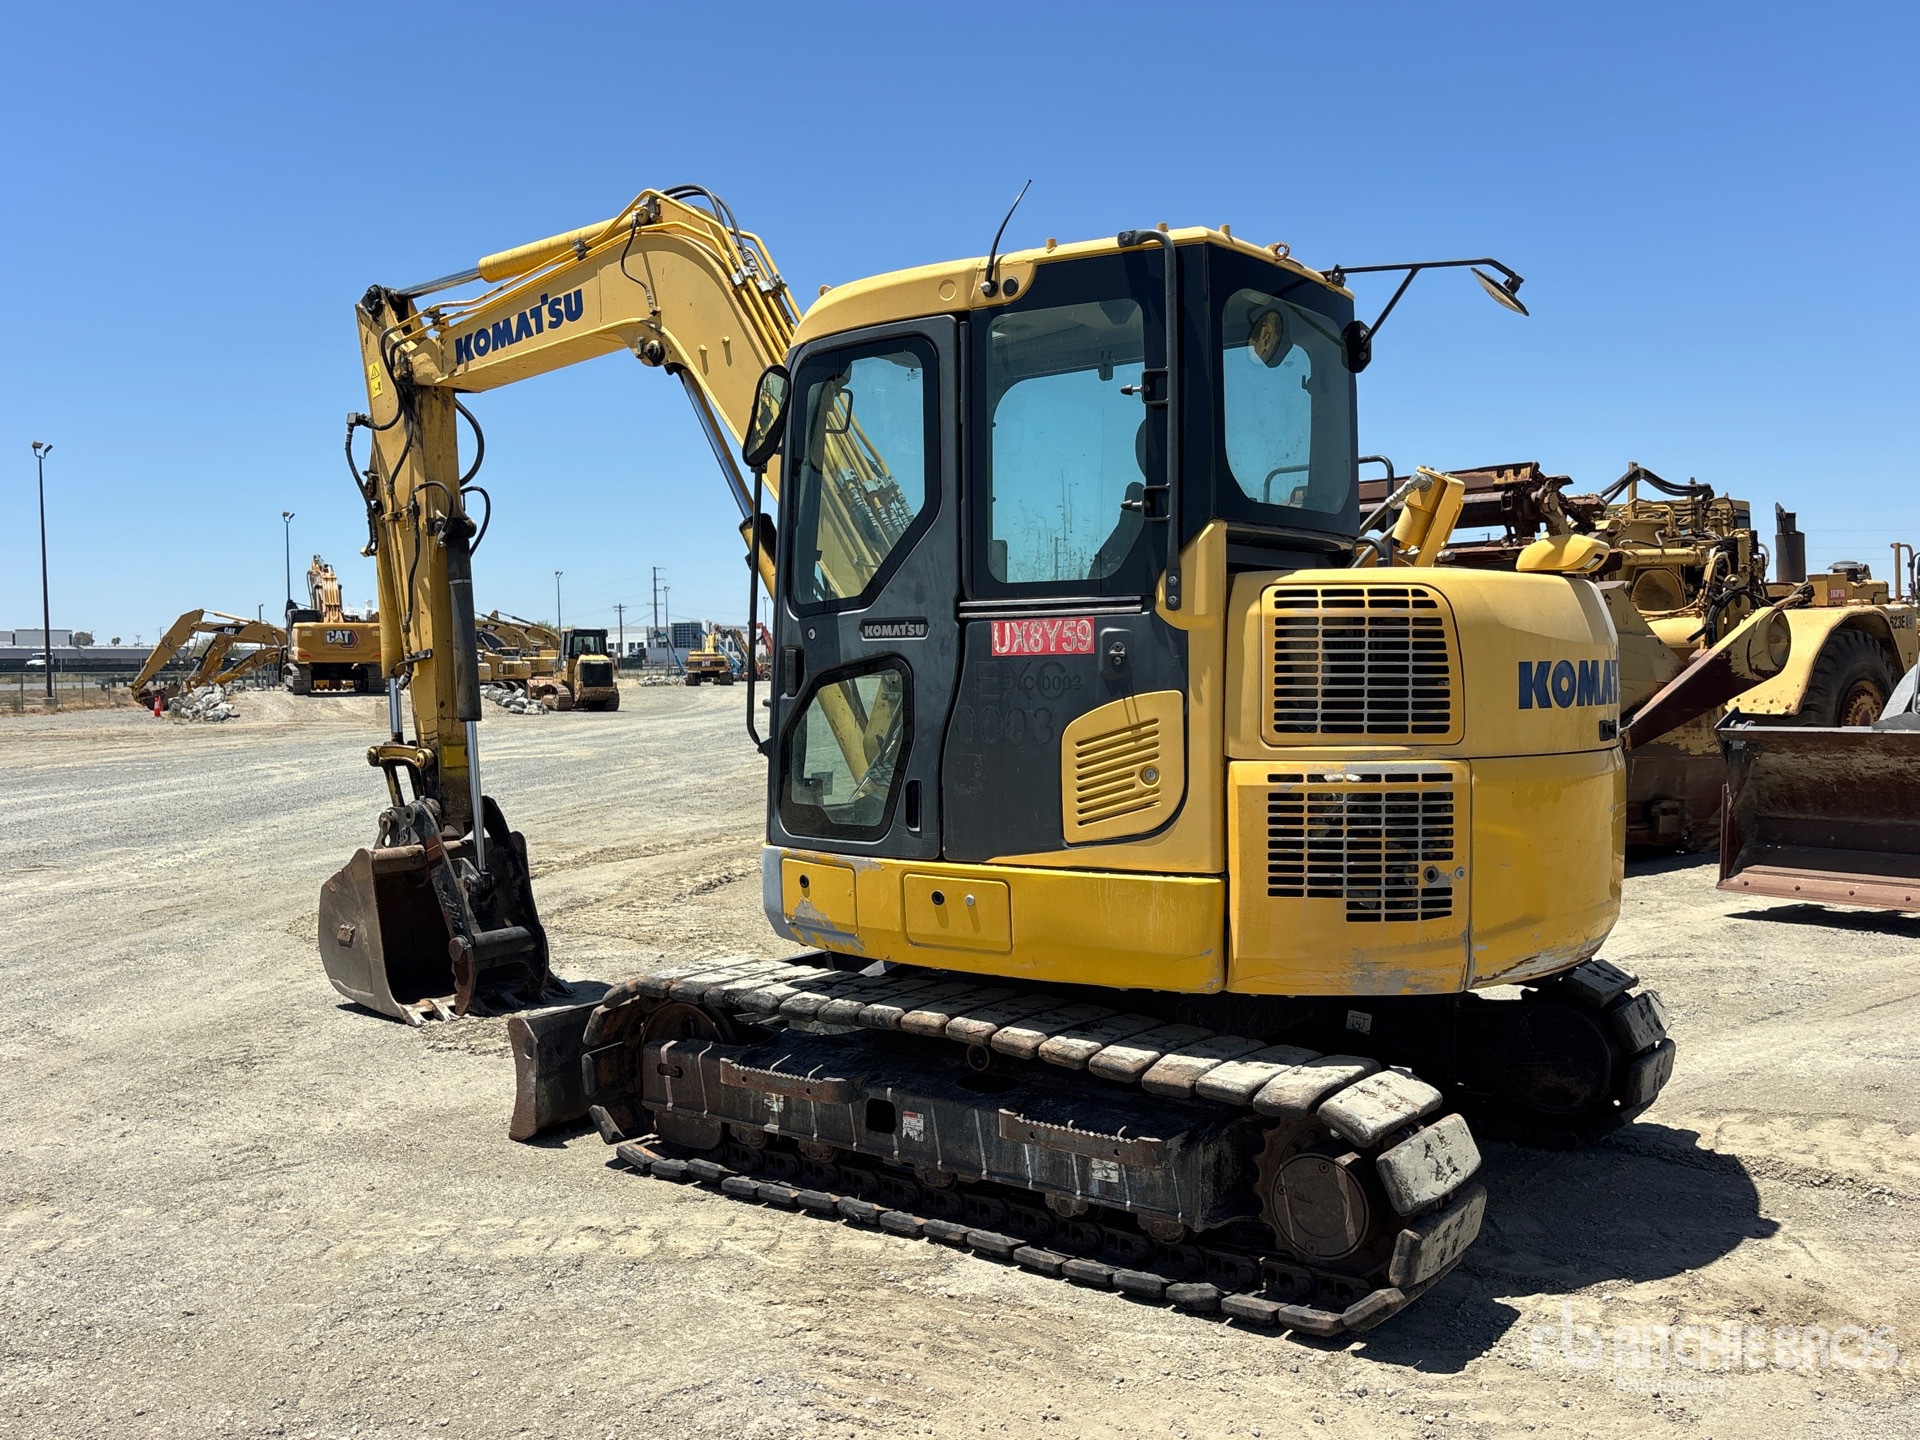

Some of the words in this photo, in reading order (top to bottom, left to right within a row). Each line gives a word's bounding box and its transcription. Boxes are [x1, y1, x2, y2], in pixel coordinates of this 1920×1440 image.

[455, 288, 584, 366] KOMATSU
[865, 622, 925, 637] KOMATSU
[1890, 615, 1905, 629] 623E
[223, 626, 237, 635] CAT
[326, 629, 351, 644] CAT
[993, 620, 1092, 653] UX8Y59
